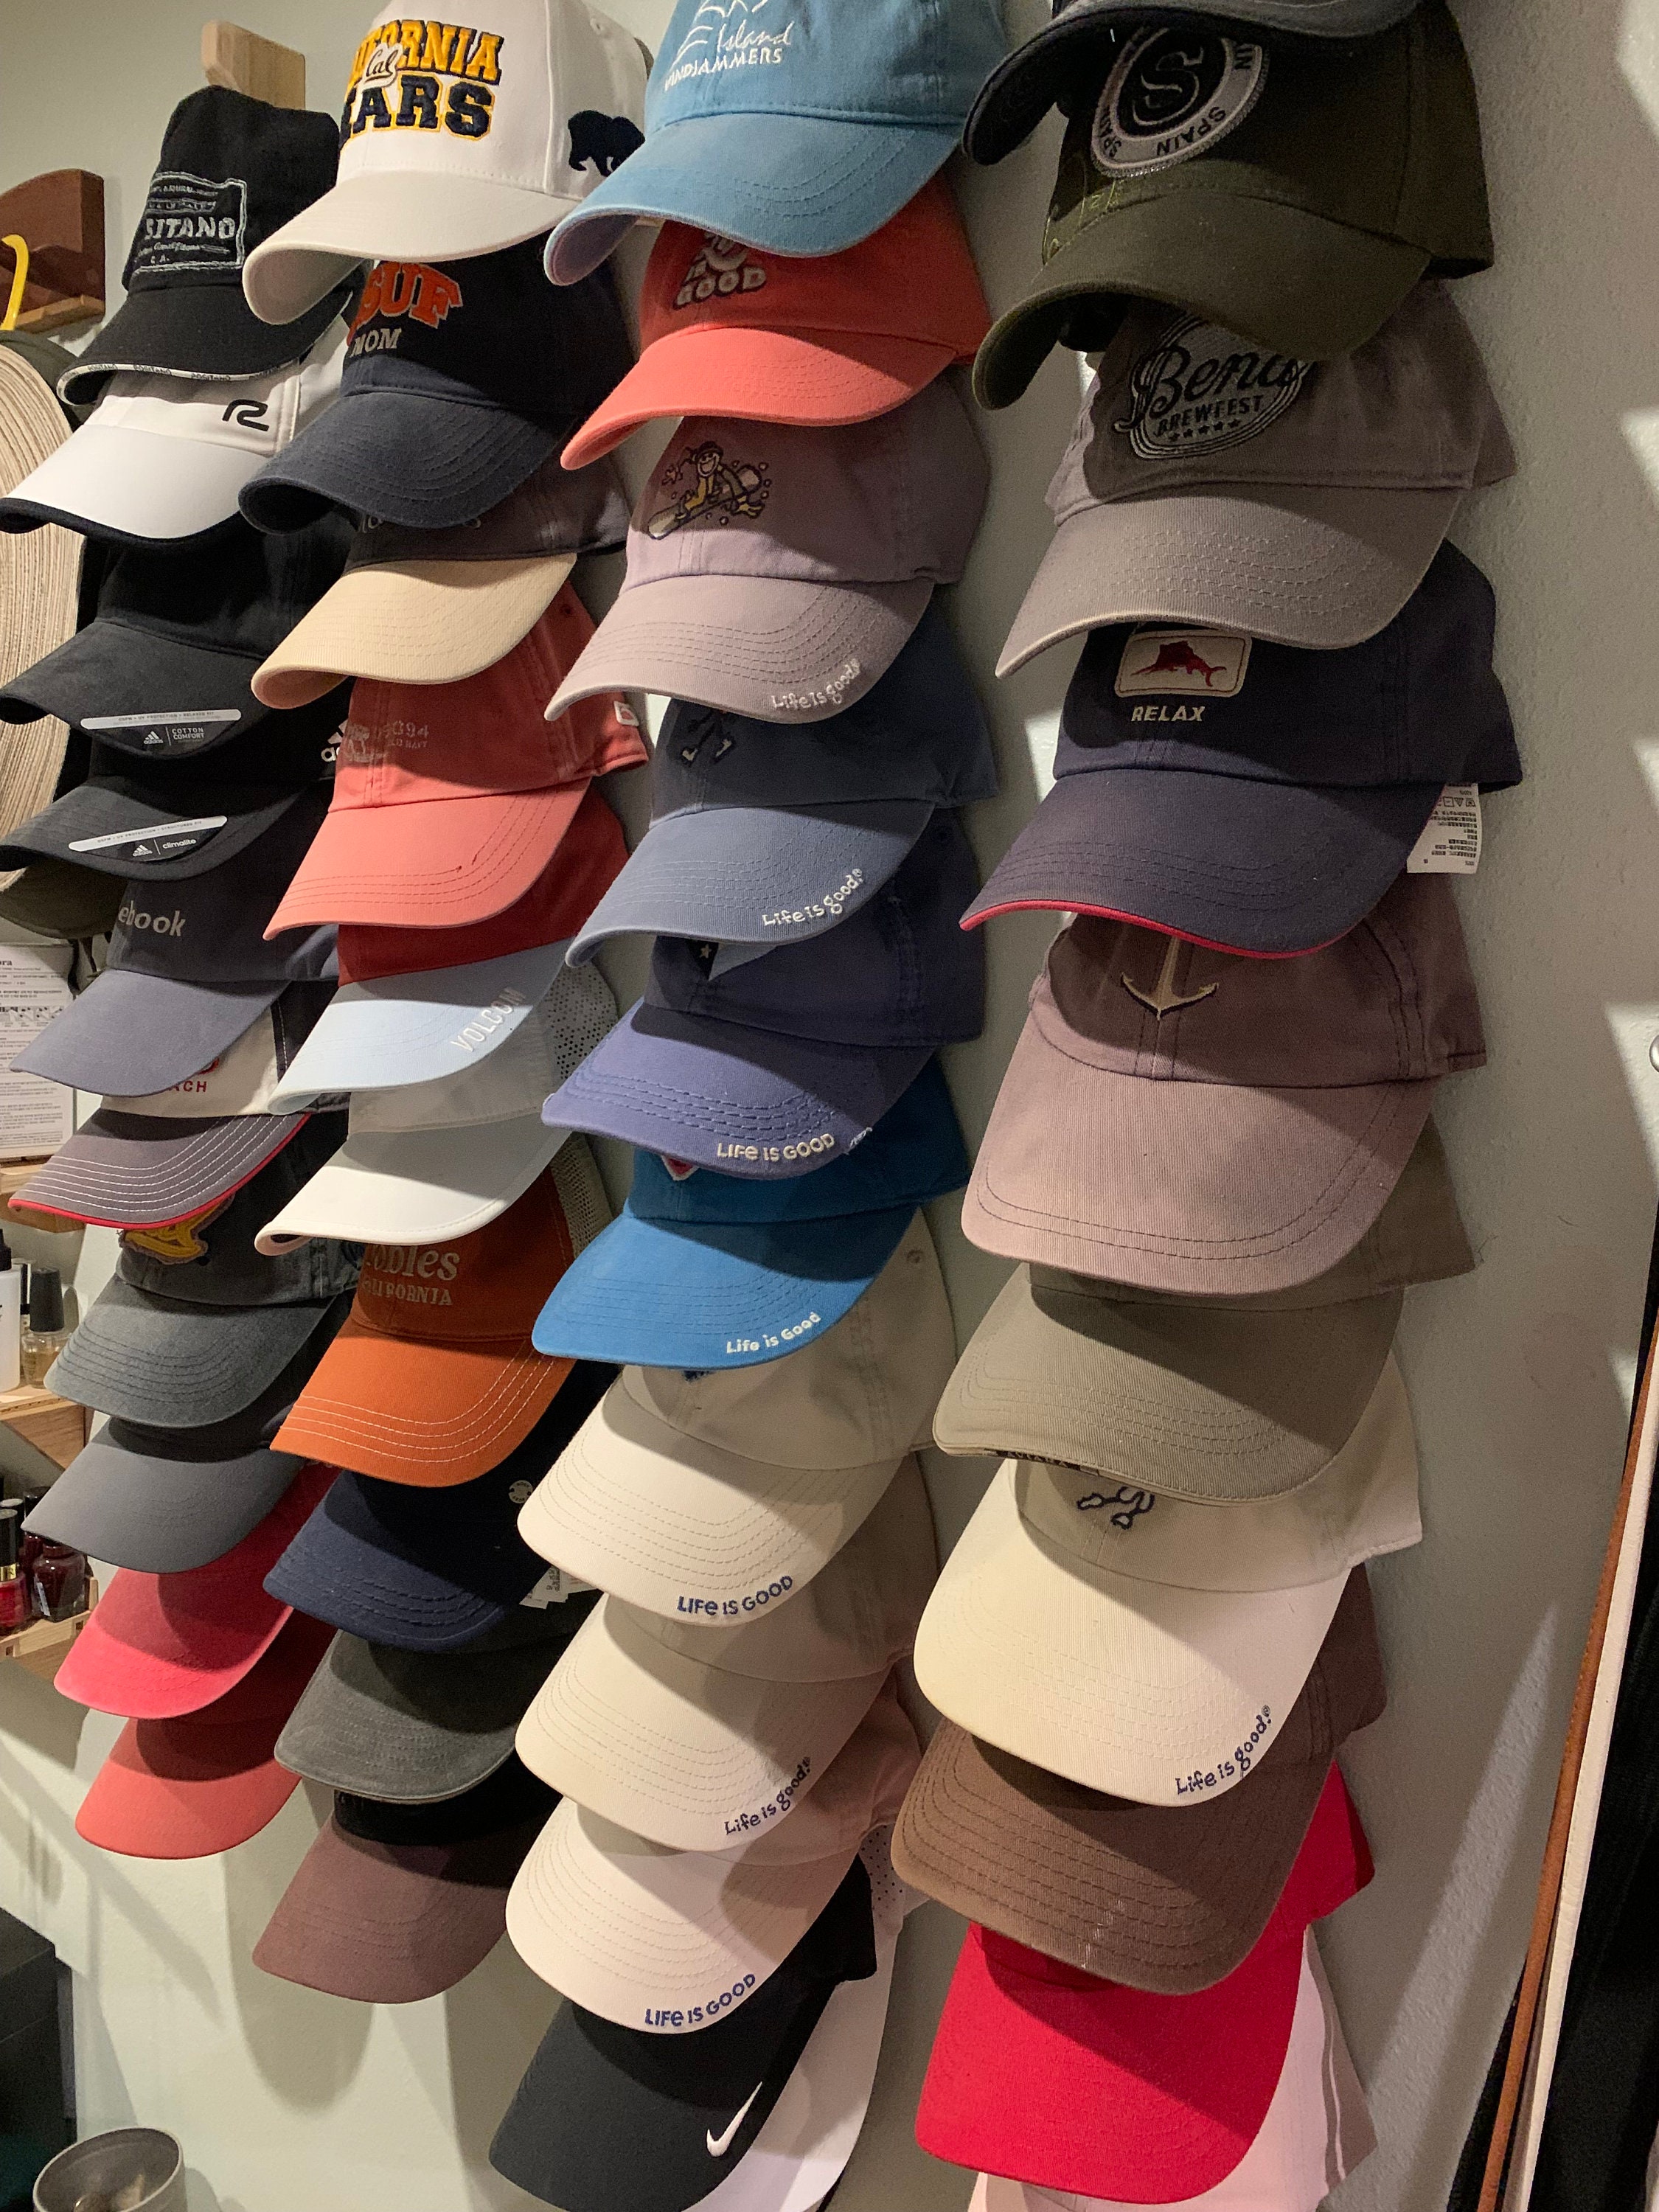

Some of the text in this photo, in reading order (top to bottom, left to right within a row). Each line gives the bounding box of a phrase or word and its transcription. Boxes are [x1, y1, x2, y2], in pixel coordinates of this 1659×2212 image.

[717, 19, 795, 52] Island
[364, 49, 399, 83] Cal
[144, 216, 236, 241] SITANO
[349, 327, 403, 358] MOM
[133, 364, 173, 376] POSITANO
[190, 372, 231, 381] POSITANO
[1154, 394, 1264, 437] BREWFEST
[771, 692, 812, 709] Life
[1131, 705, 1206, 722] RELAX
[173, 732, 204, 740] COMFORT
[162, 838, 197, 849] climalite
[118, 900, 186, 936] ebook
[762, 909, 806, 926] Life
[804, 904, 825, 918] is
[451, 988, 526, 1052] VOLCOM
[783, 1133, 835, 1160] GOOD
[726, 1311, 821, 1354] Life is Good
[741, 1575, 793, 1611] GOOD
[1175, 1770, 1217, 1795] Life
[1217, 1761, 1235, 1779] is
[724, 1812, 761, 1835] Life
[761, 1804, 776, 1819] is
[706, 1973, 756, 2015] GOOD
